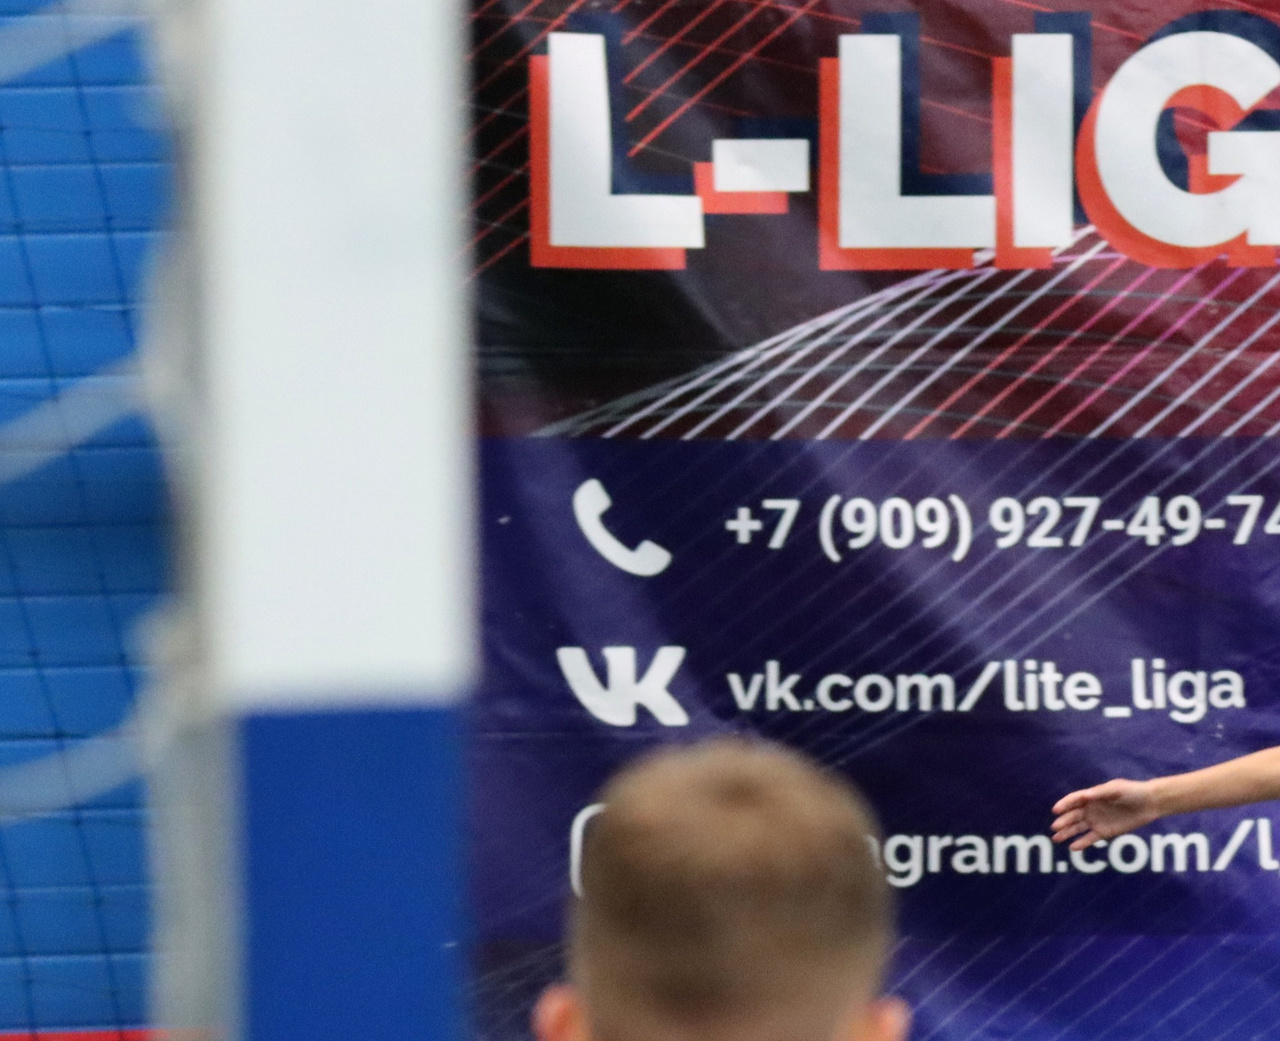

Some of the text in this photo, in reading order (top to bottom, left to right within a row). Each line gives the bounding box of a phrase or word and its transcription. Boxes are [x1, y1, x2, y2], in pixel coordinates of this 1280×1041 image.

[725, 498, 799, 550] +7
[818, 494, 973, 562] (909)
[727, 659, 1247, 723] vk.com/lite_liga
